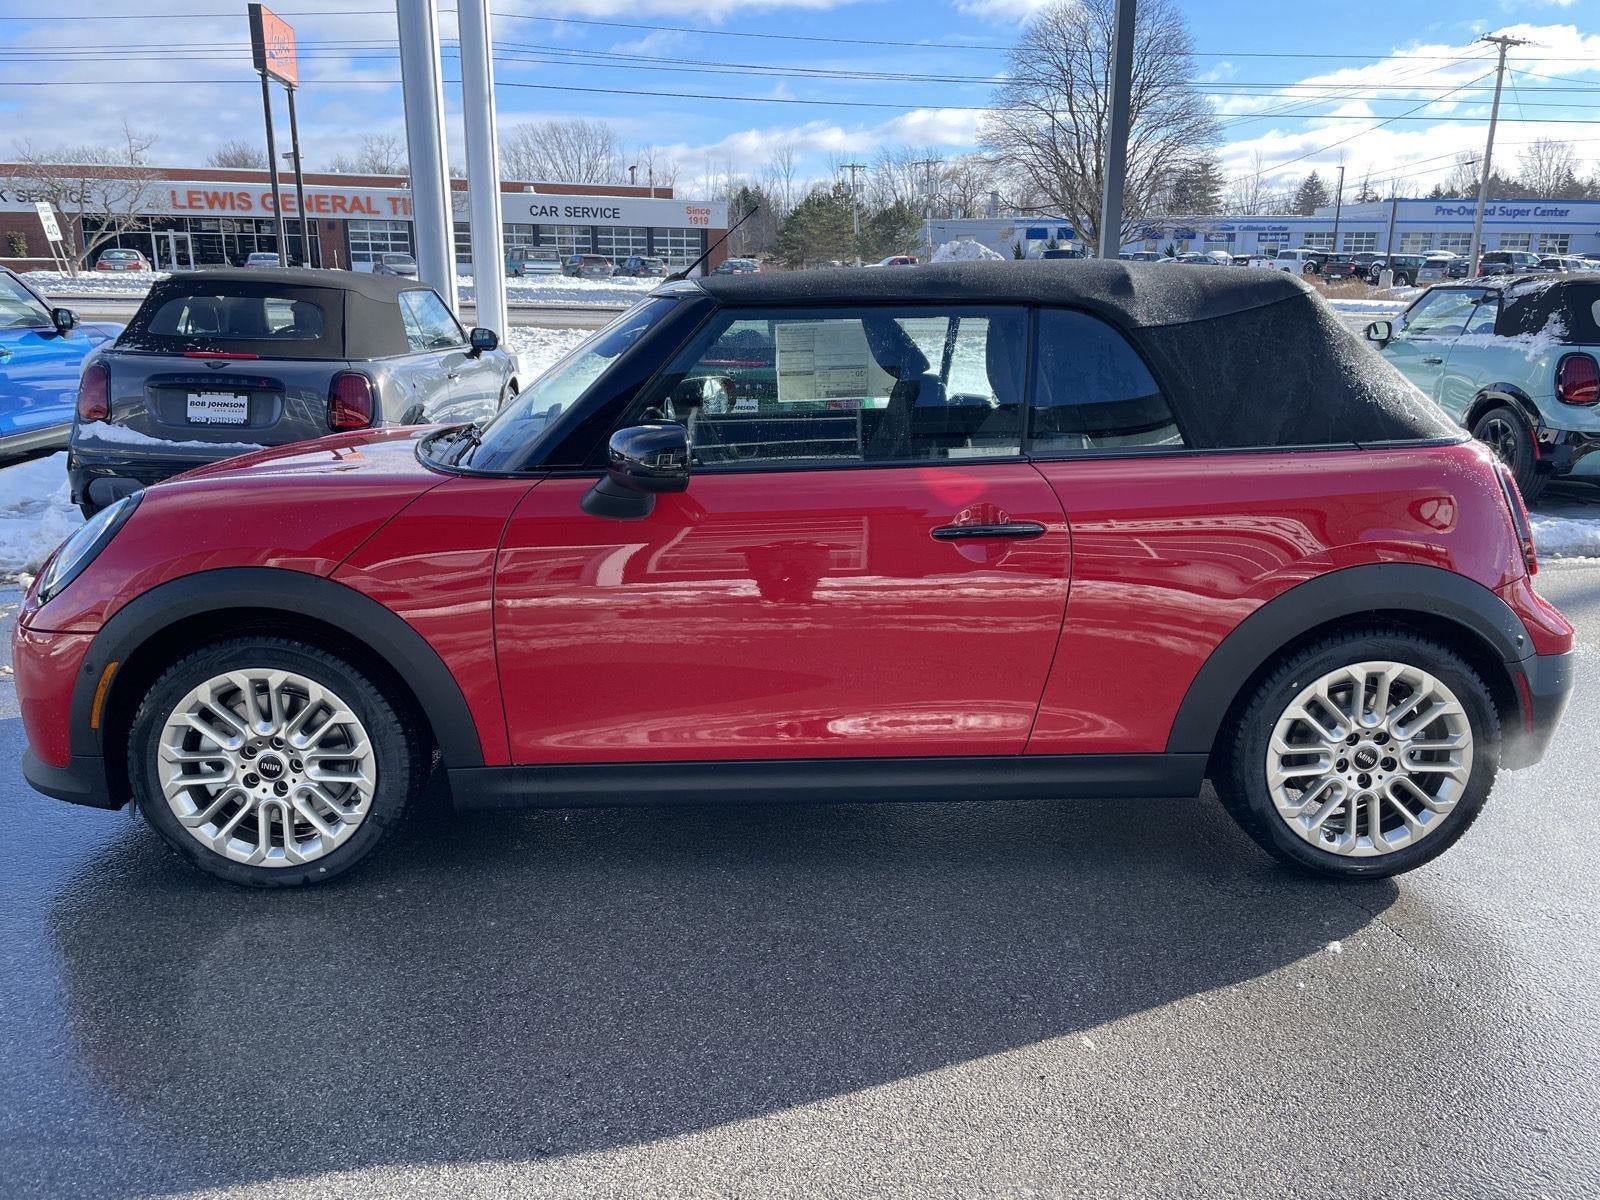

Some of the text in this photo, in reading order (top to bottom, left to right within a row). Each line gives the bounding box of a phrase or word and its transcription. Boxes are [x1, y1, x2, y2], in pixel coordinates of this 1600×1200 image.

[170, 190, 253, 211] LEWIS
[260, 192, 381, 215] GENERAL
[529, 205, 621, 219] CAR SERVICE
[686, 205, 711, 215] Since
[1499, 206, 1531, 219] Super
[1533, 206, 1570, 217] Center
[688, 216, 709, 225] 1919
[46, 224, 59, 236] 40
[207, 400, 246, 408] JOHNSON
[1357, 751, 1375, 765] MINI
[260, 762, 280, 771] MINI
